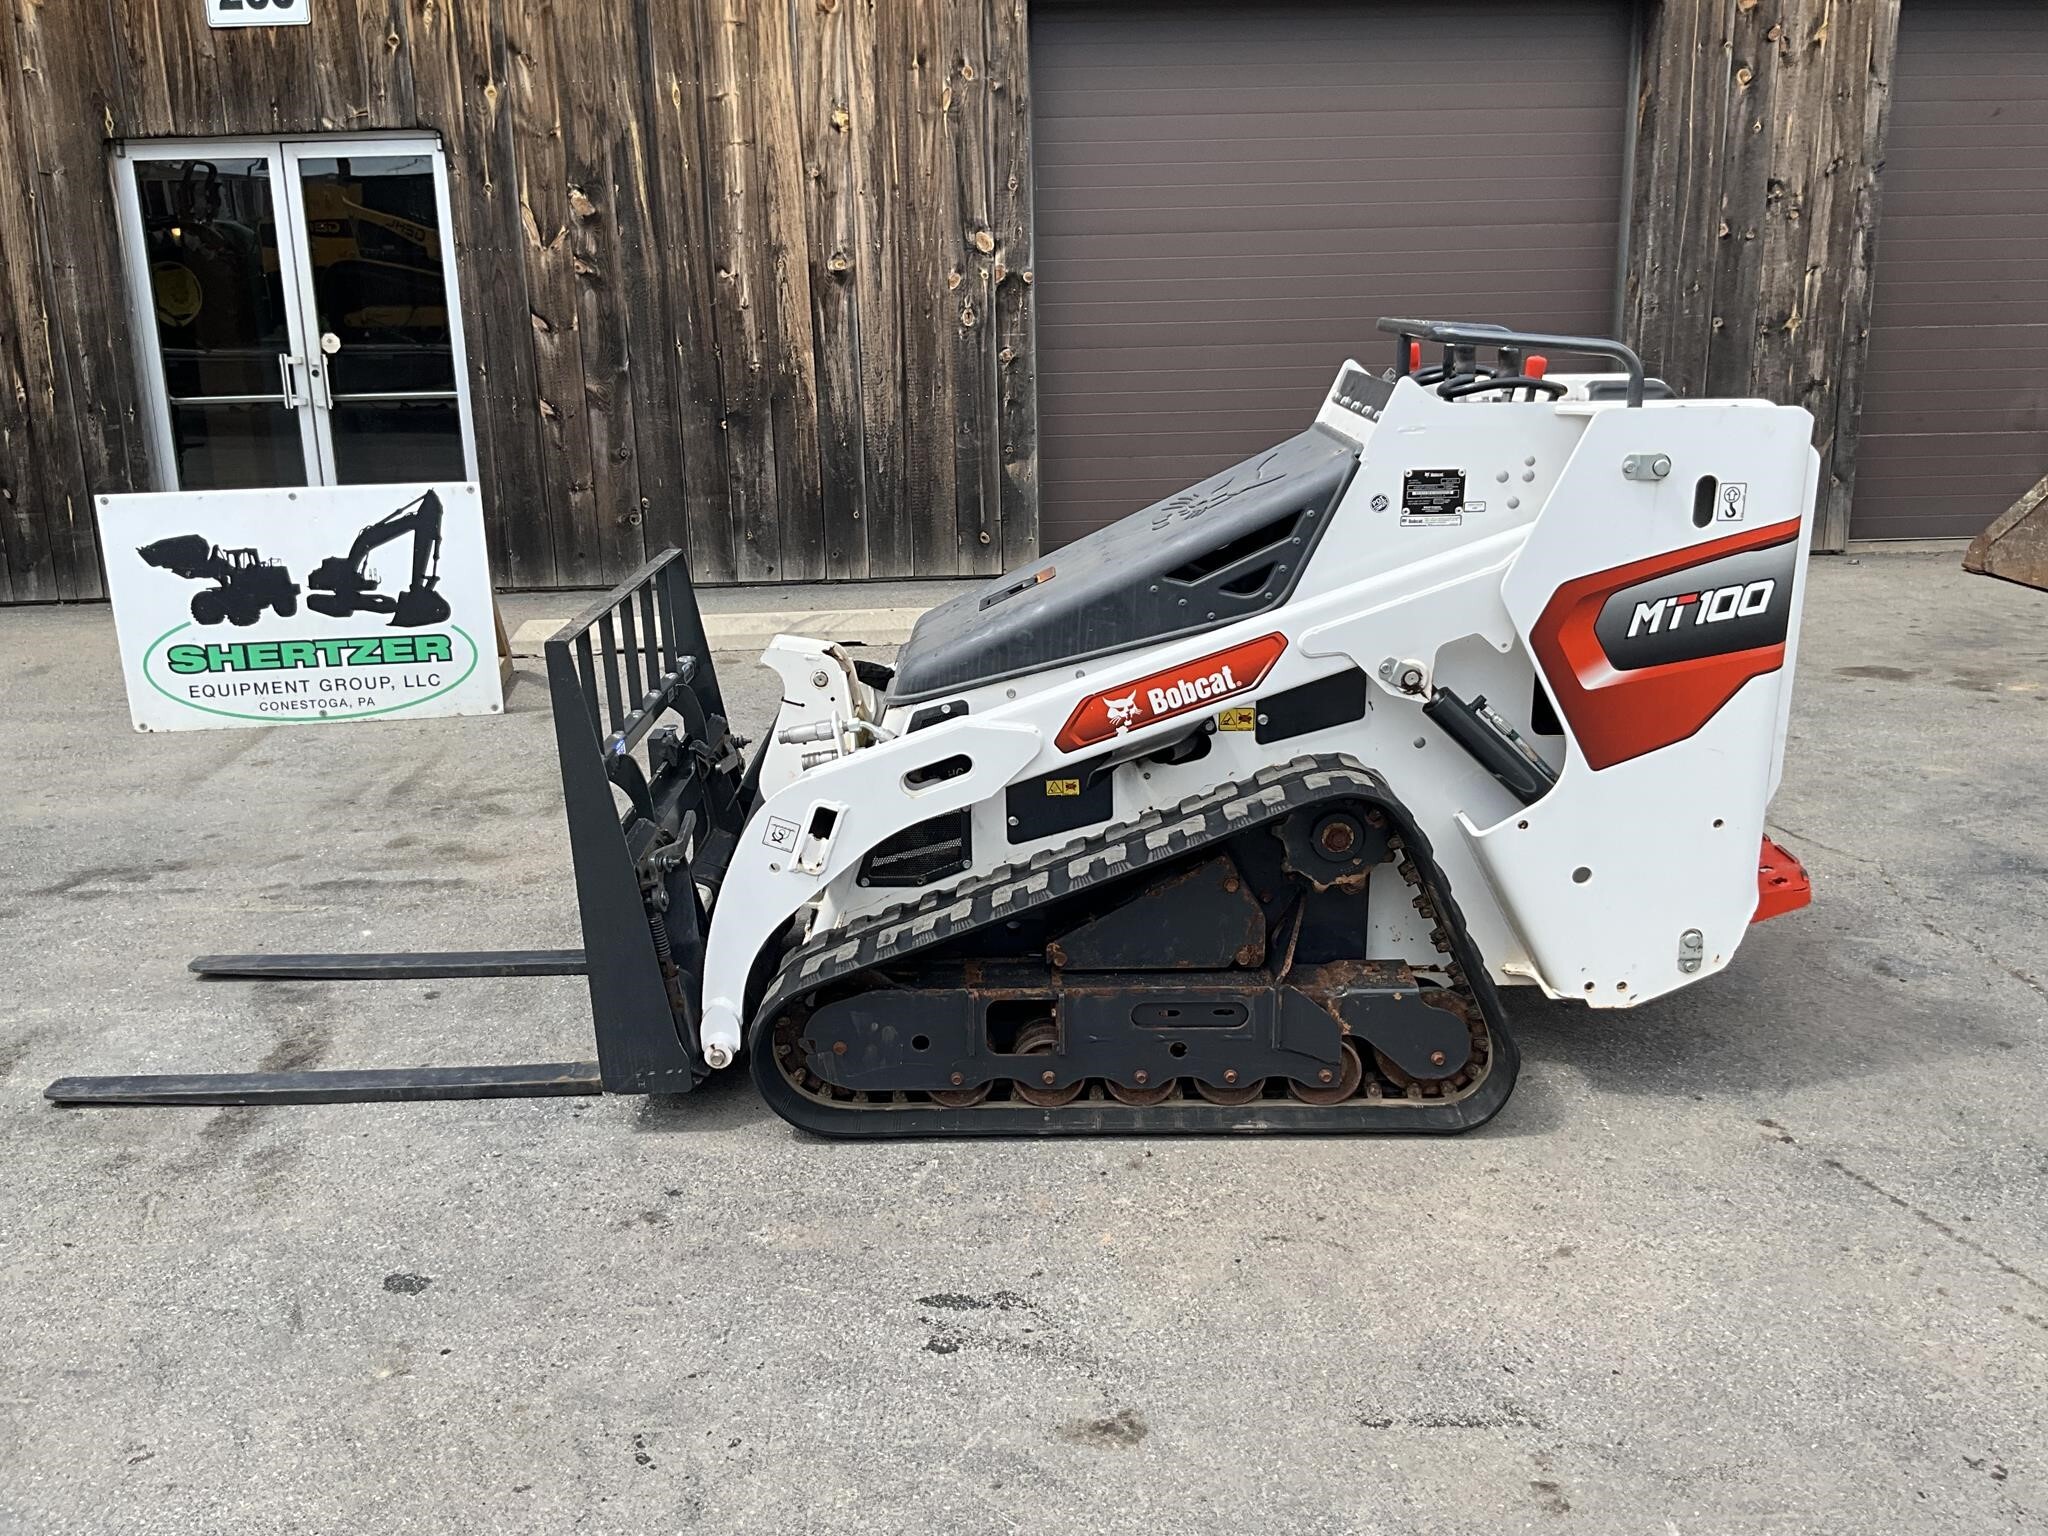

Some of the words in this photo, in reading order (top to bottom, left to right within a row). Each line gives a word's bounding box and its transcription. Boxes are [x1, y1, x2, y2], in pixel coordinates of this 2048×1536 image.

[1626, 579, 1776, 638] MT100
[167, 634, 453, 674] SHERTZER
[188, 680, 310, 699] EQUIPMENT
[319, 676, 395, 692] GROUP,
[403, 673, 441, 689] LLC
[259, 698, 353, 712] CONESTOGA,
[358, 697, 376, 707] PA
[1147, 665, 1237, 715] Bobcat
